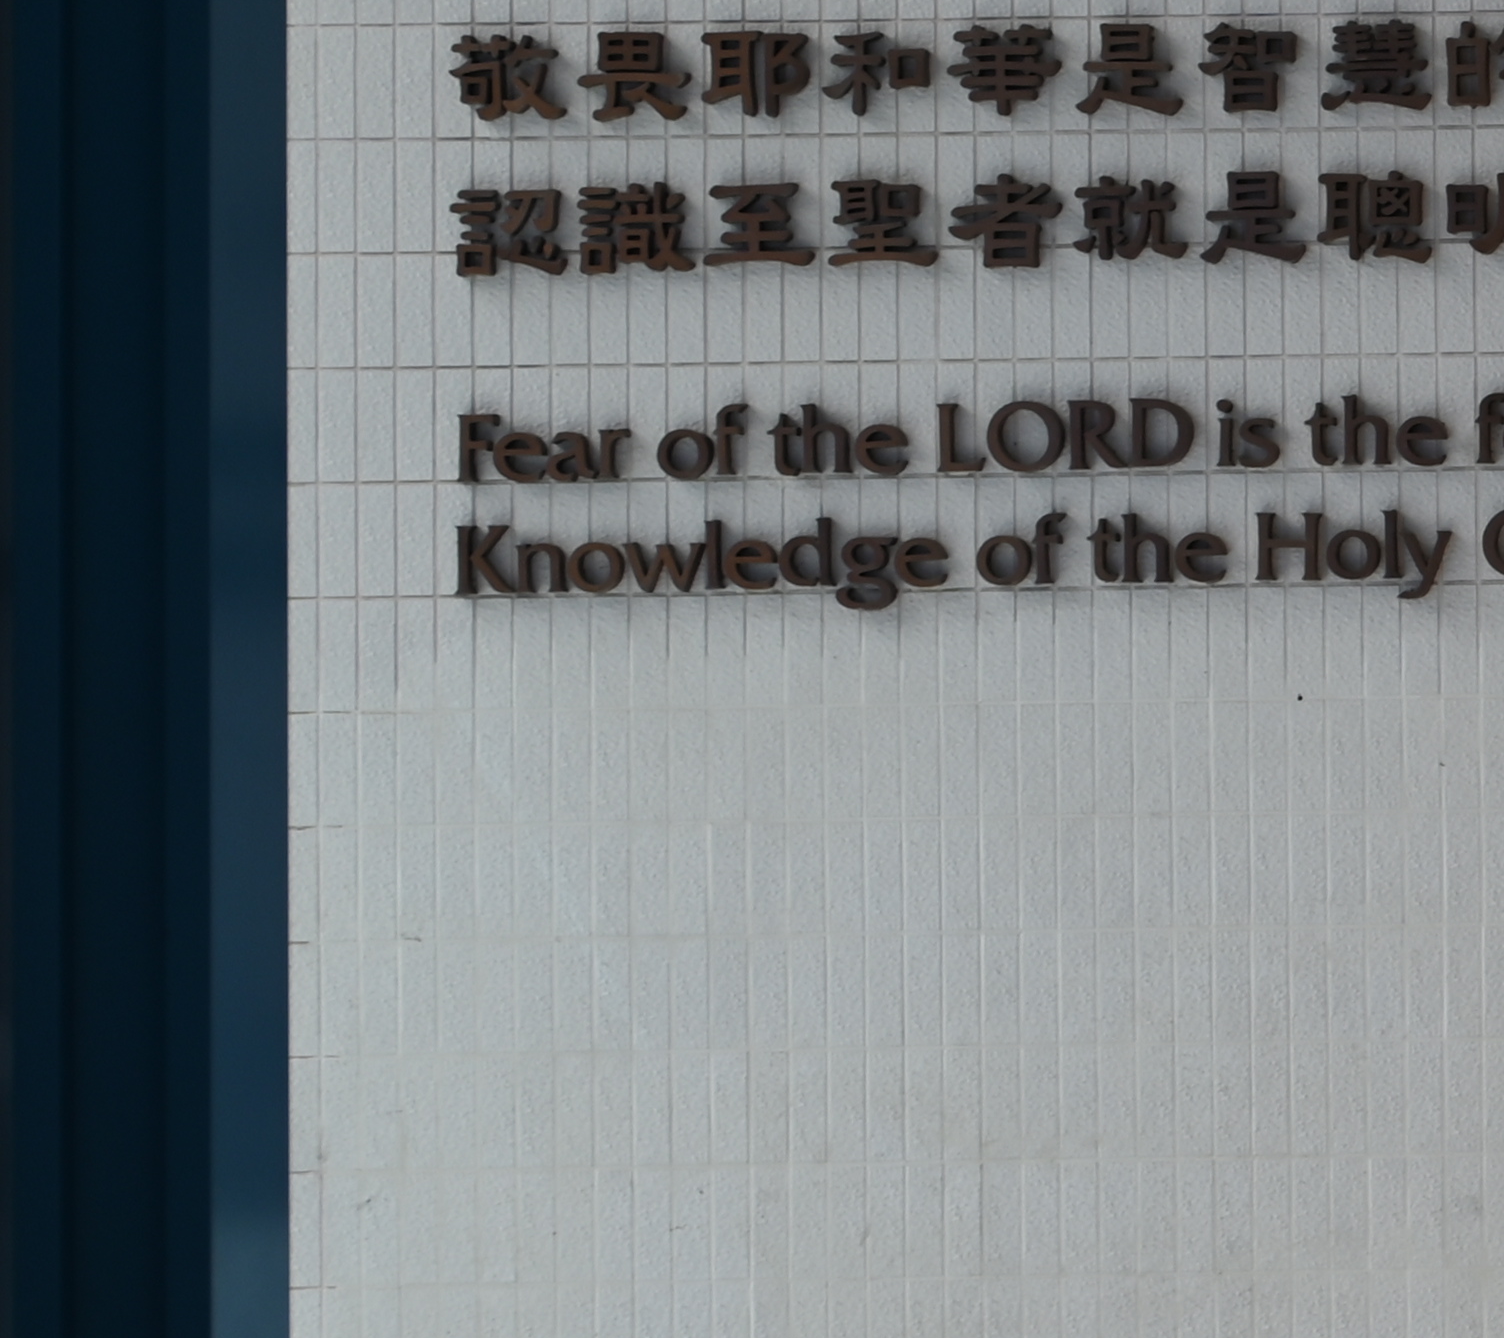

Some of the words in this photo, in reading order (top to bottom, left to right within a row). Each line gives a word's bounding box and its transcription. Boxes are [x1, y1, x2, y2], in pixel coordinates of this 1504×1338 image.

[456, 412, 632, 483] Fear
[656, 403, 749, 480] of
[767, 403, 909, 476] the
[935, 397, 1195, 474] LORD
[1215, 399, 1282, 469] is
[1305, 395, 1448, 466] the
[456, 516, 949, 610] Knowledge
[976, 512, 1067, 587] of
[1087, 512, 1228, 585] the
[1255, 509, 1453, 600] Holy
